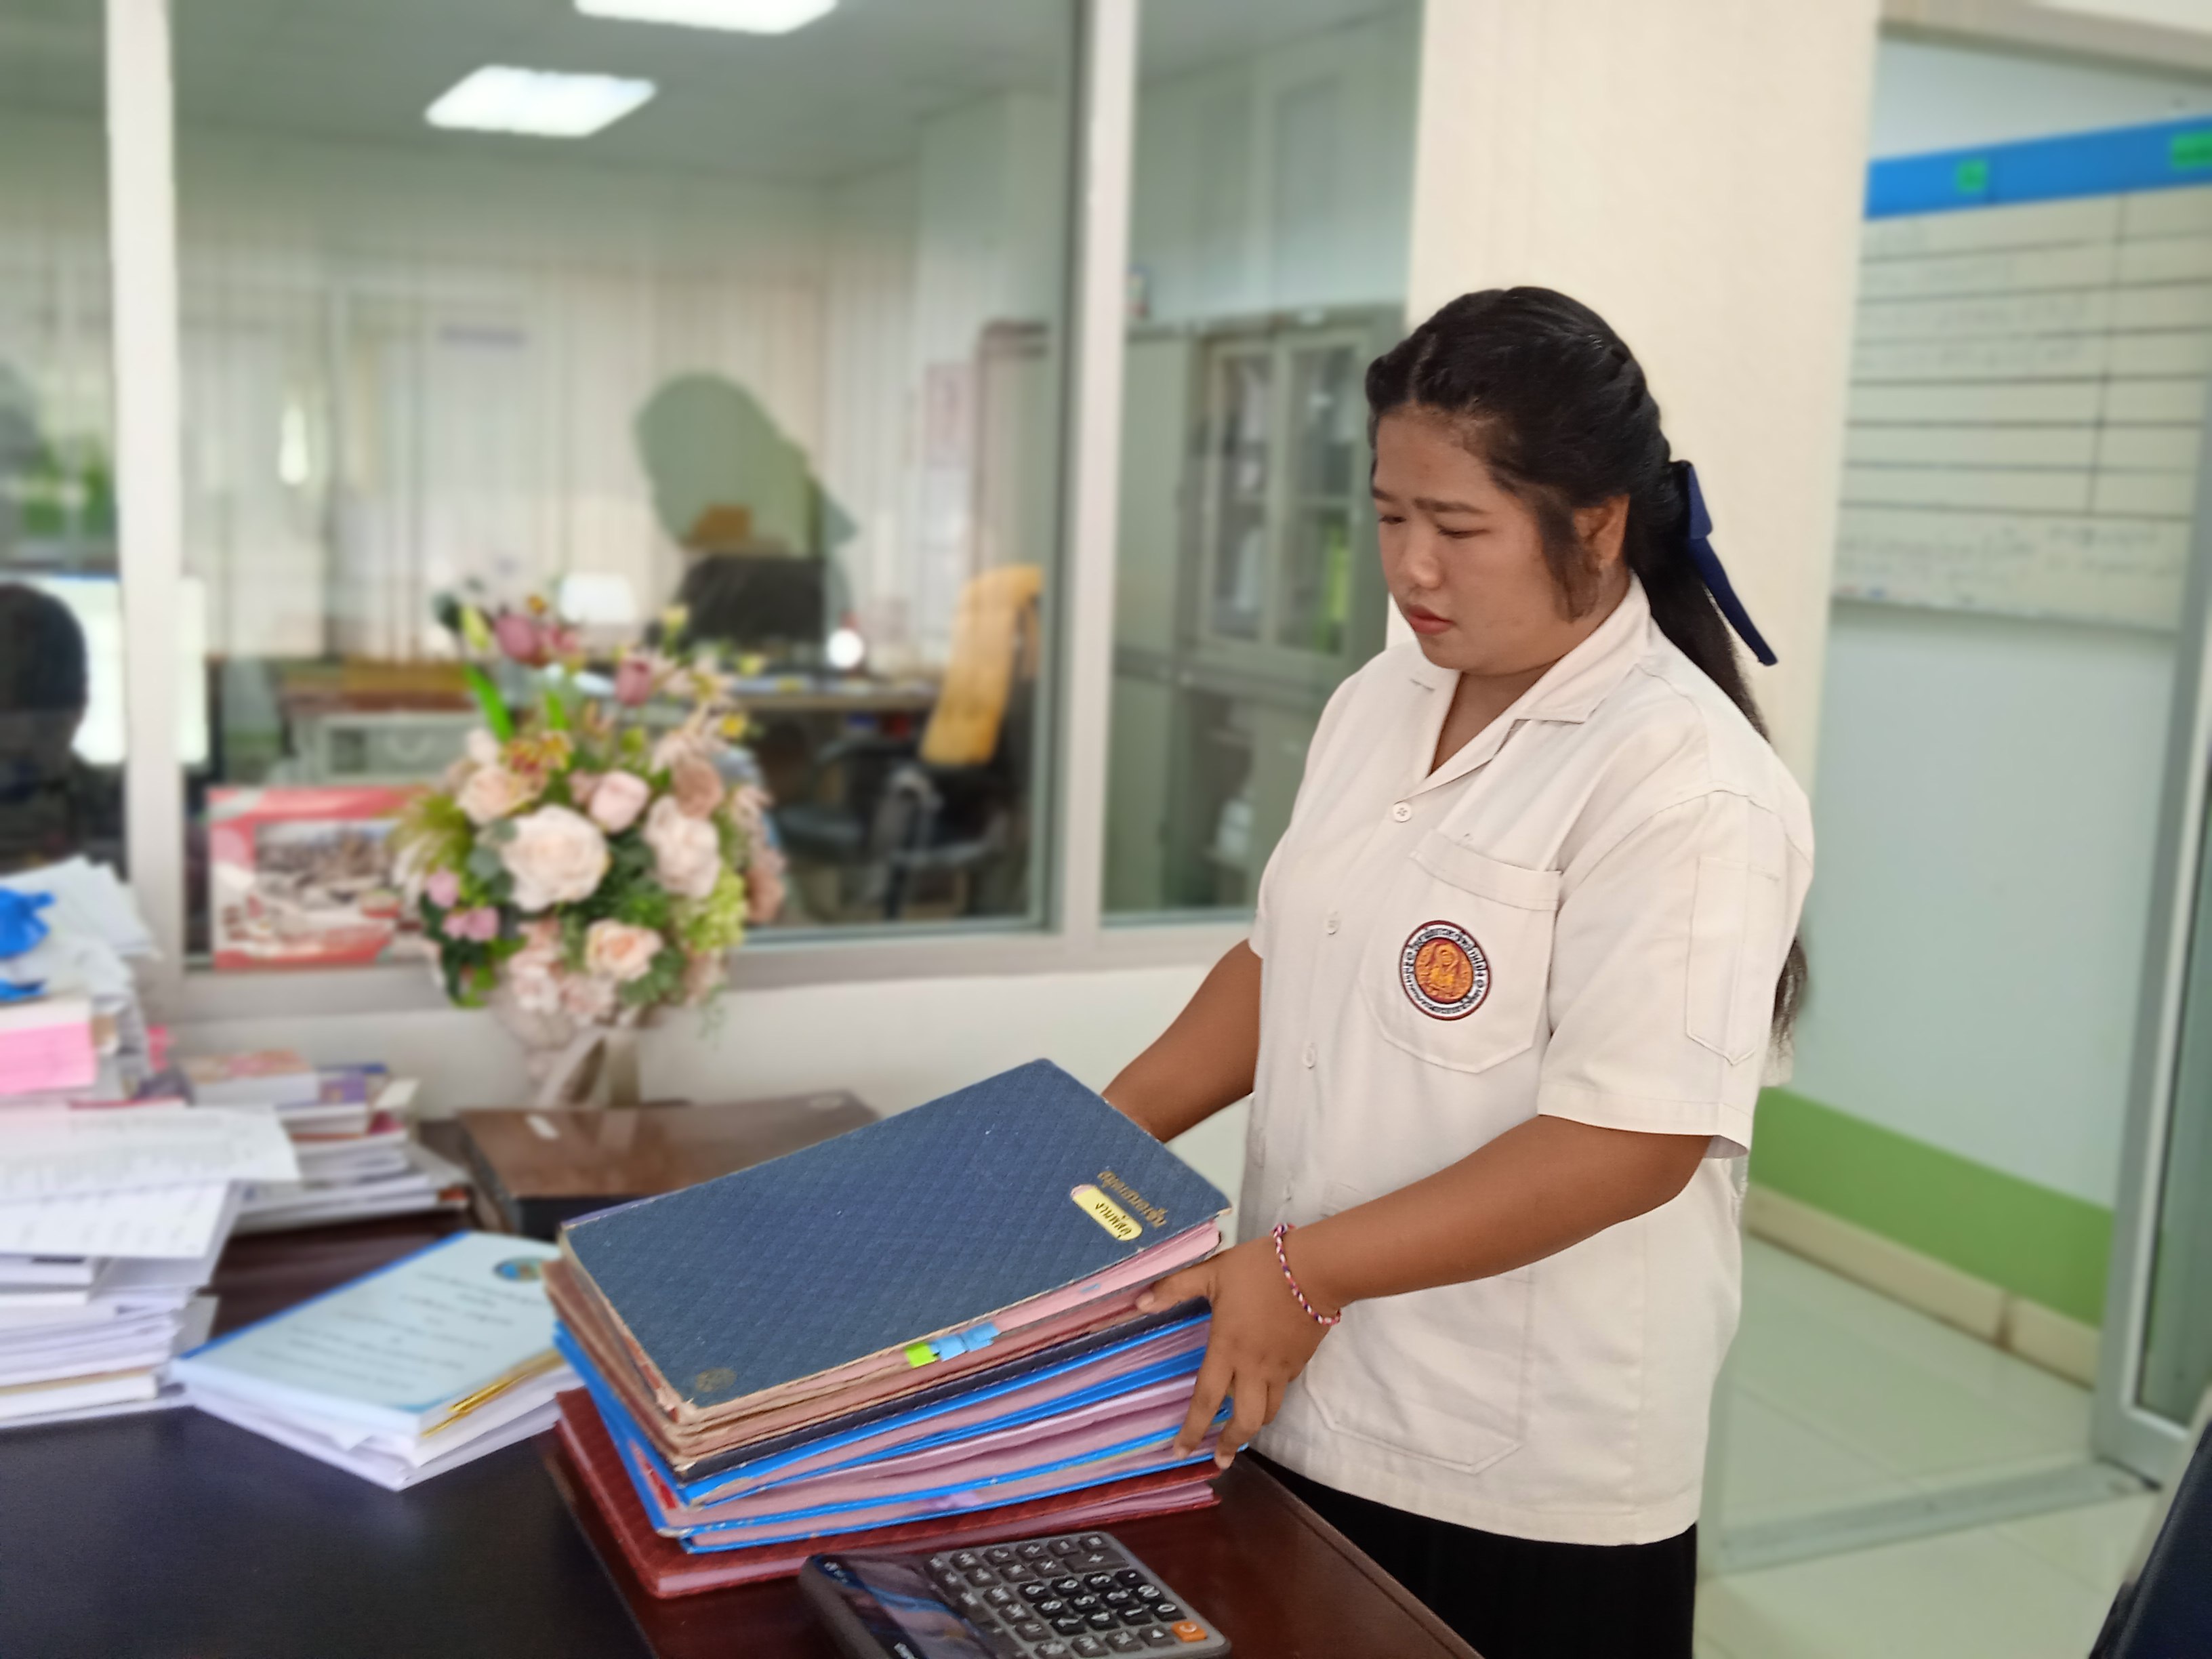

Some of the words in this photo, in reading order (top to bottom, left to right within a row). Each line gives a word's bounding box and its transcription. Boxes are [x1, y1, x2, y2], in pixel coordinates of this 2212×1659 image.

[1090, 1575, 1111, 1584] 3
[1058, 1580, 1078, 1589] 6
[1025, 1586, 1045, 1595] 9
[1107, 1590, 1129, 1599] 2
[1139, 1584, 1162, 1597] 00
[1041, 1599, 1063, 1610] 8
[1074, 1595, 1096, 1605] 5
[1125, 1607, 1143, 1616] 1
[1158, 1603, 1177, 1612] 0
[1091, 1612, 1109, 1621] 4
[1057, 1616, 1080, 1627] 7
[1179, 1623, 1197, 1633] C
